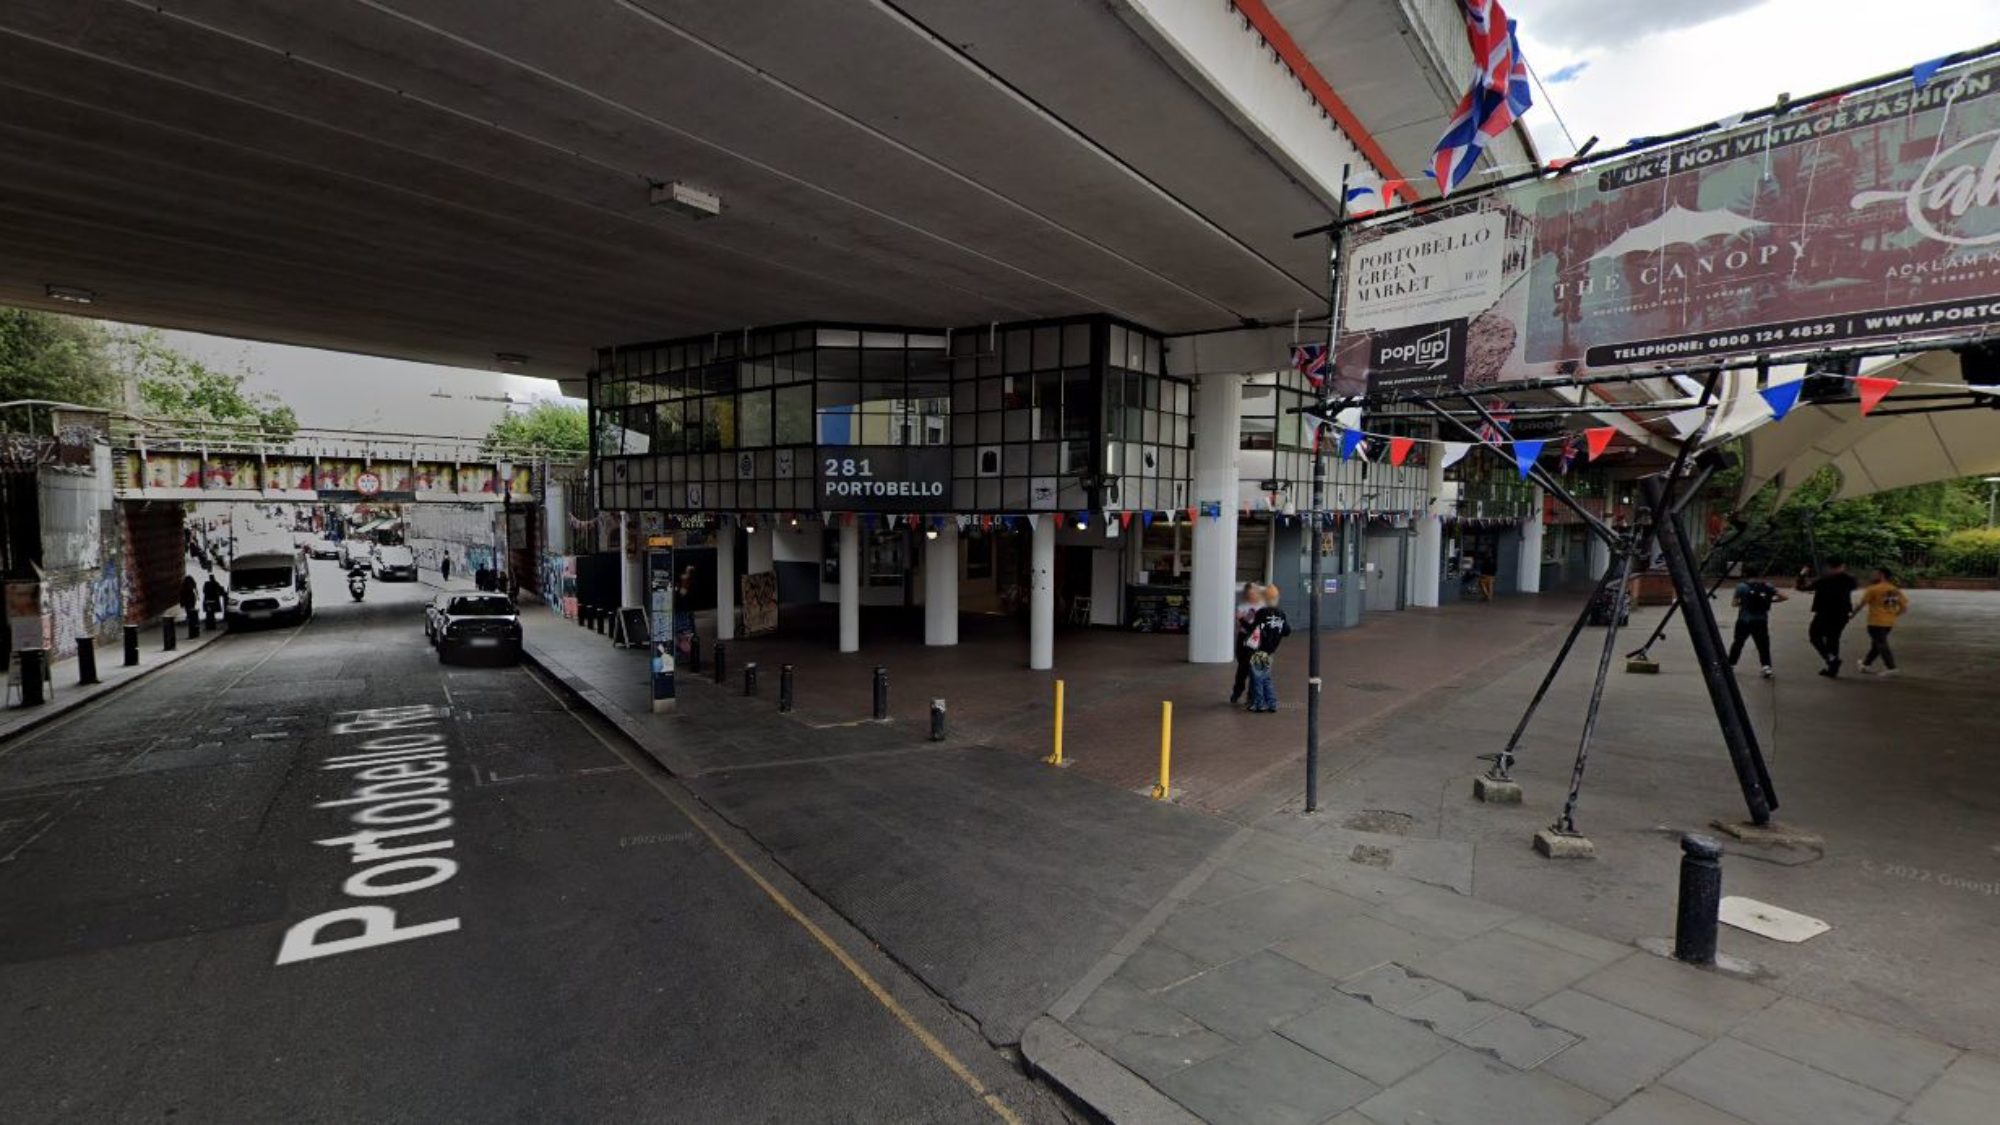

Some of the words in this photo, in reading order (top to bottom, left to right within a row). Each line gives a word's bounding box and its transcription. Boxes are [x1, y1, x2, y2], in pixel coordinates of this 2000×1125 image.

[1623, 157, 1671, 182] UK'S
[1679, 145, 1728, 170] NO.1
[1736, 111, 1849, 153] VINTAGE
[1855, 74, 1991, 123] FASHION
[1360, 228, 1490, 271] PORTOBELLO
[1358, 262, 1416, 287] GREEN
[1554, 274, 1620, 300] THE
[1640, 238, 1811, 286] CANOPY
[1886, 254, 1978, 278] ACKLAM
[1931, 270, 1984, 284] STREET
[1358, 275, 1433, 302] MARKET
[1614, 340, 1704, 360] TELEPHONE:
[1709, 334, 1750, 349] 0800
[1755, 329, 1784, 343] 124
[1789, 323, 1835, 338] 4832
[824, 458, 873, 477] 281
[825, 481, 943, 496] PORTOBELLO
